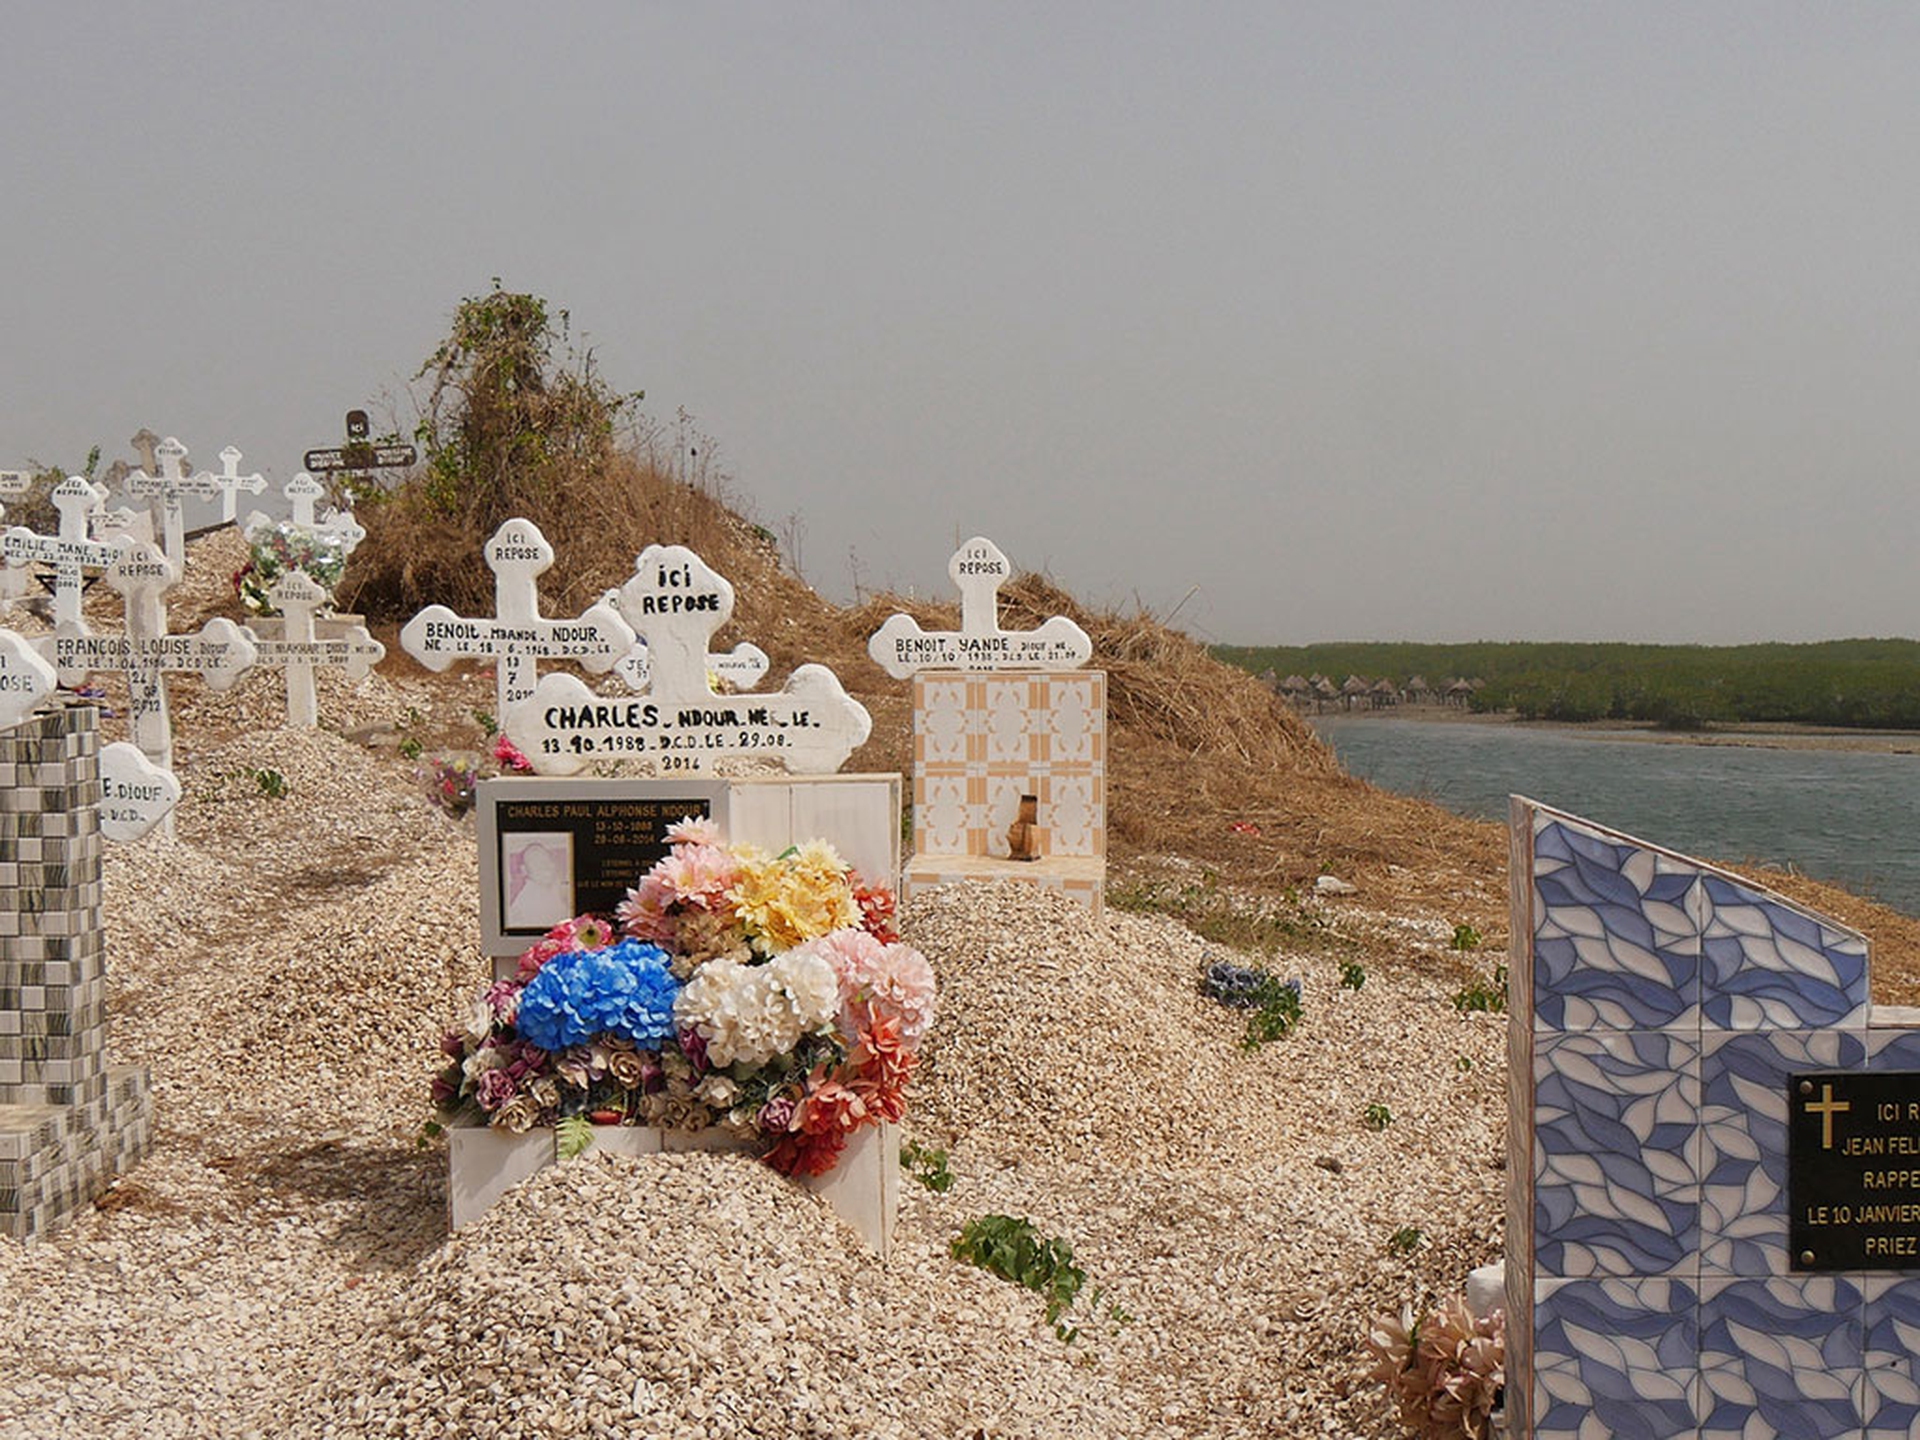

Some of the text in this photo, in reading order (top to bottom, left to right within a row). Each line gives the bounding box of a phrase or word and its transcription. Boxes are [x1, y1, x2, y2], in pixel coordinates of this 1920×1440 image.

[506, 534, 526, 544] ICI
[130, 552, 149, 562] ICI
[495, 547, 540, 560] REPOSE
[968, 550, 988, 559] ICI
[118, 564, 164, 577] REPOSE
[959, 562, 1002, 575] REPOSE
[643, 594, 720, 615] REPOSE
[552, 626, 598, 642] NDOUR
[142, 639, 191, 655] LOUISE
[896, 639, 946, 652] BENOIT
[958, 638, 1010, 652] YANDE
[0, 674, 34, 692] OSE
[544, 704, 659, 730] CHARLES
[507, 804, 702, 818] CHARLES PAUL ALPHONSE NDOUR
[1878, 1103, 1900, 1122] ICI
[1842, 1138, 1884, 1156] JEAN
[1864, 1171, 1920, 1188] RAPPE
[1808, 1204, 1920, 1224] LE 10 JANVIER
[1865, 1237, 1917, 1255] PRIEZ
